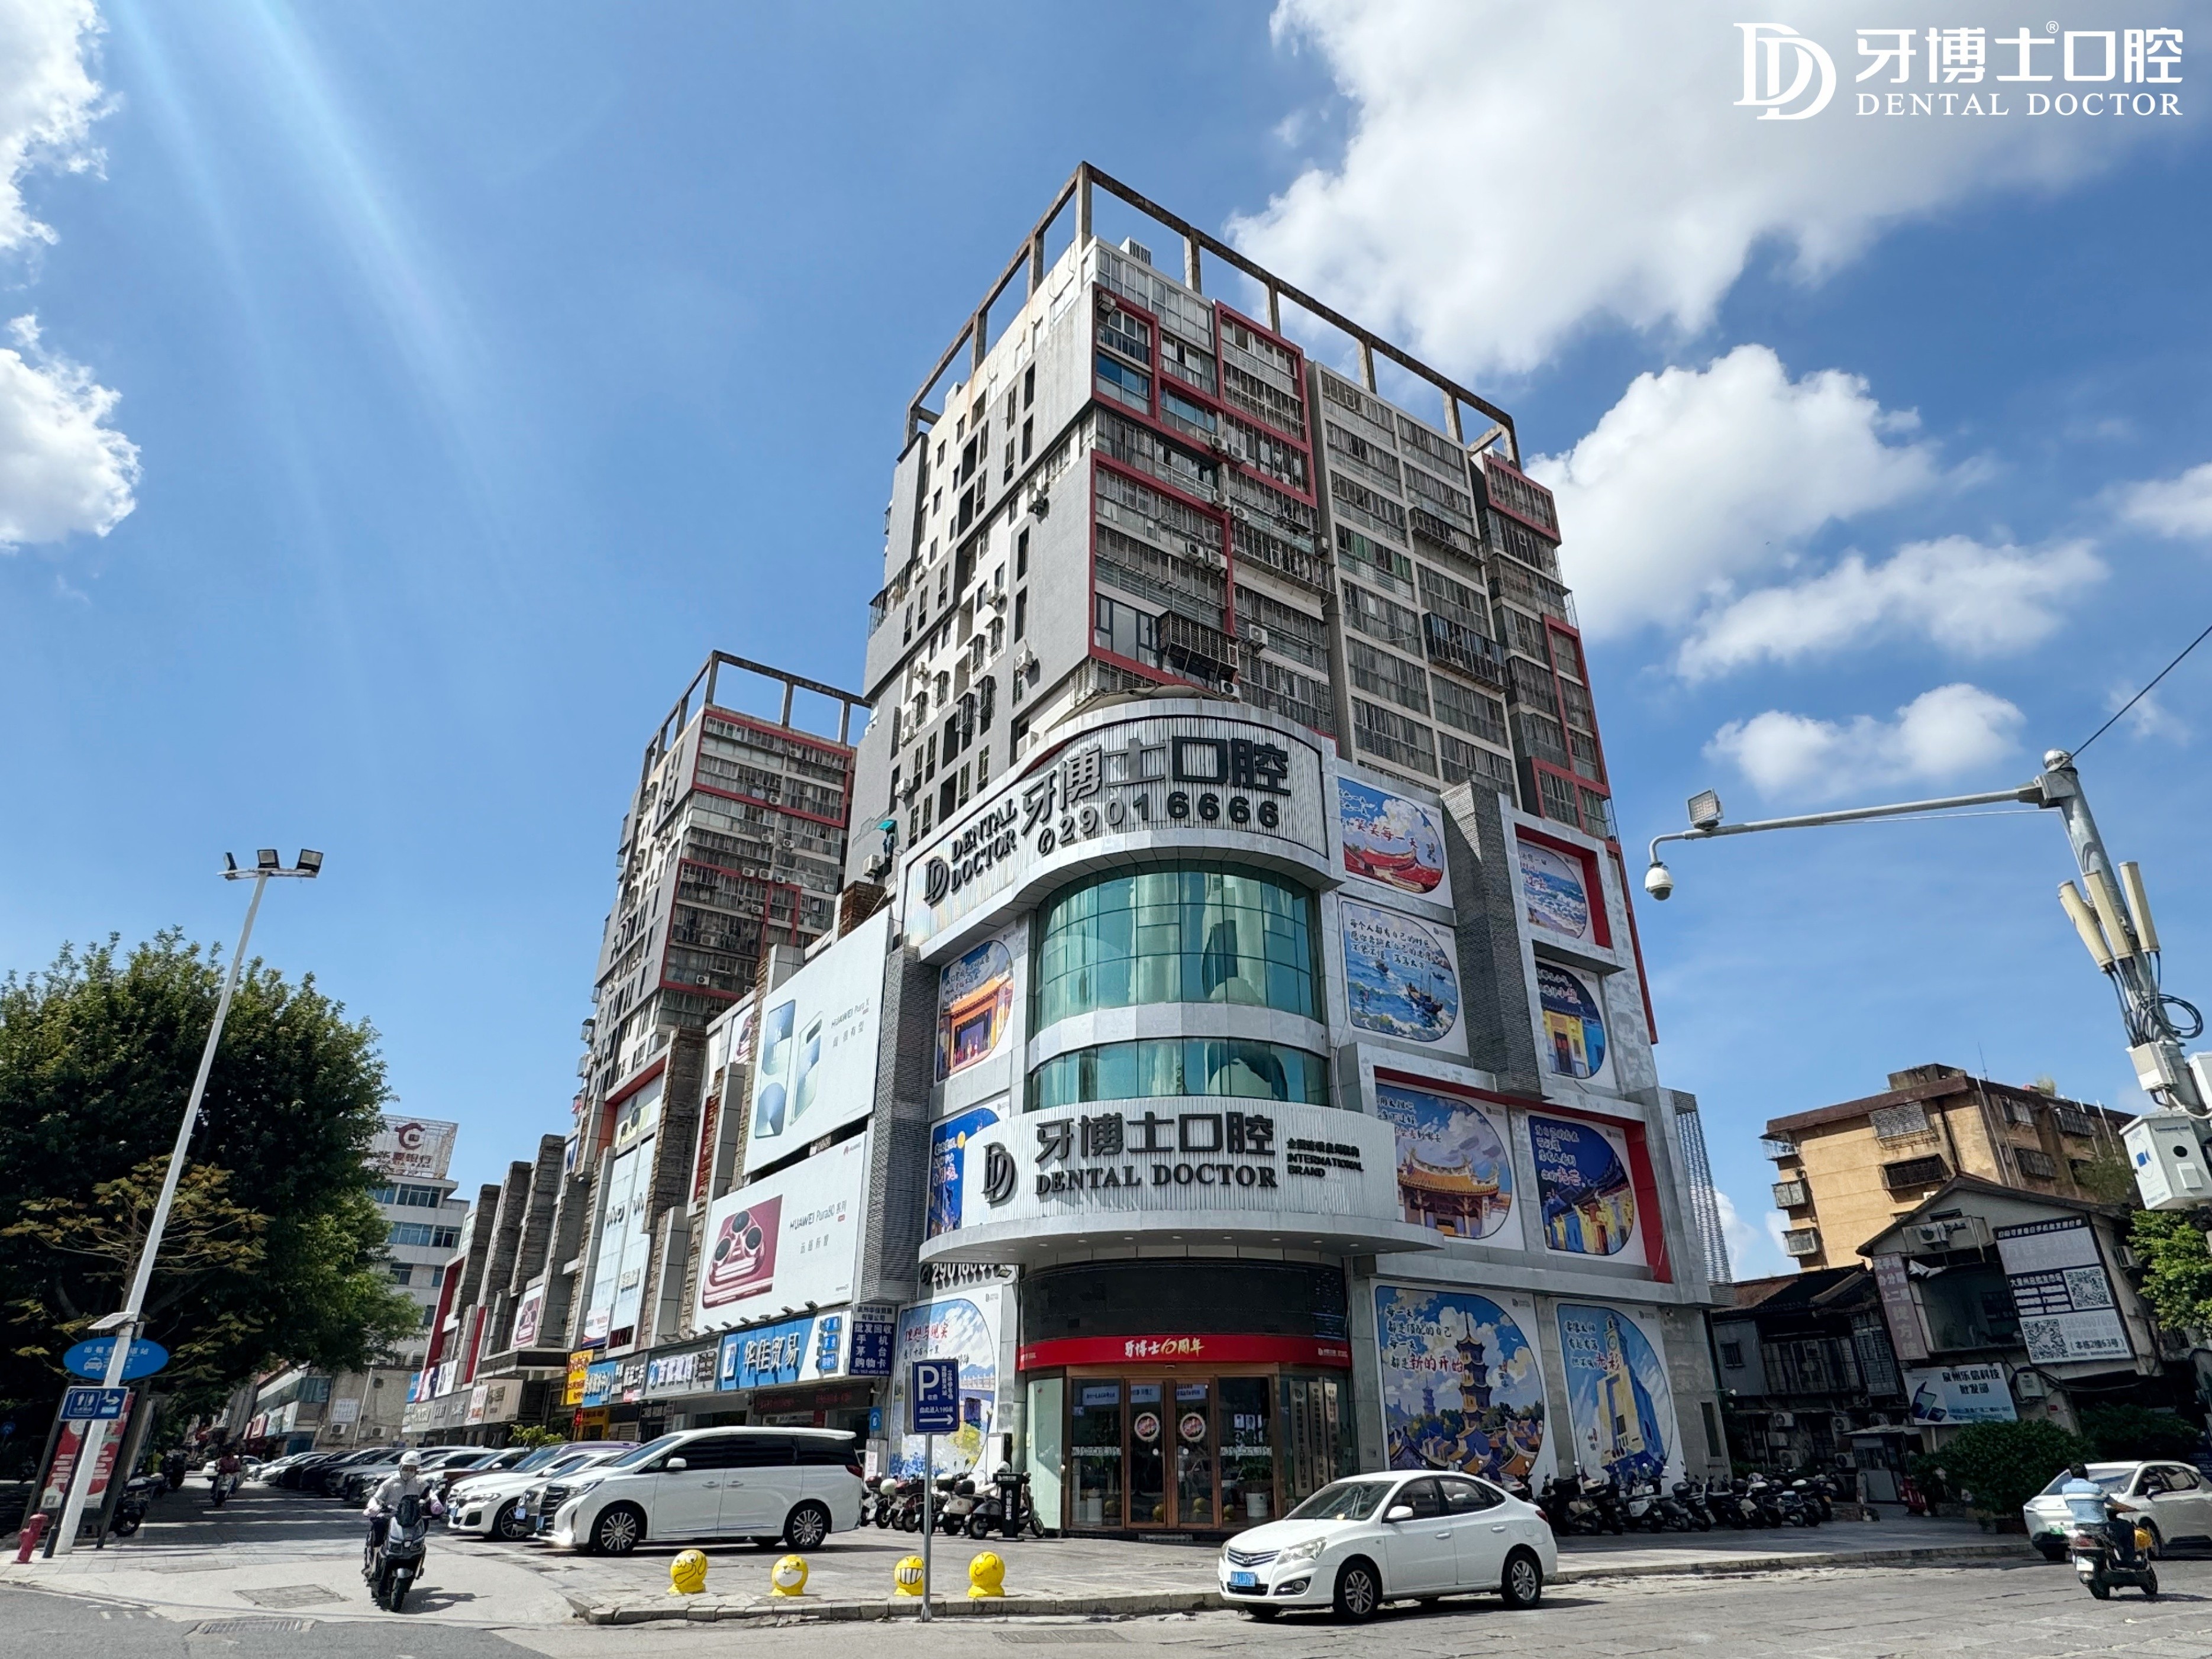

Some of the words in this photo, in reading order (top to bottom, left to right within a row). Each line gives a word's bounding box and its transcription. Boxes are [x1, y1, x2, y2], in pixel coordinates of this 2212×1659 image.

[1021, 736, 1290, 836] 牙博士口腔
[951, 799, 1018, 862] DENTAL
[1060, 790, 1278, 847] 29016666
[951, 829, 1018, 893] DOCTOR
[1036, 1111, 1277, 1164] 牙博士口腔
[1287, 1153, 1364, 1171] INTERNATIONAL
[1288, 1164, 1325, 1177] BRAND
[1036, 1164, 1142, 1195] DENTAL
[1152, 1163, 1278, 1188] DOCTOR
[790, 1212, 815, 1231] HUAWEI
[1387, 1306, 1413, 1319] 每一天
[854, 1323, 892, 1334] 批发回收
[744, 1332, 799, 1371] 华佳贸易
[1389, 1338, 1417, 1350] 每一天
[855, 1358, 886, 1368] 购物卡
[1391, 1355, 1464, 1373] 都是新的开始
[918, 1366, 939, 1402] P
